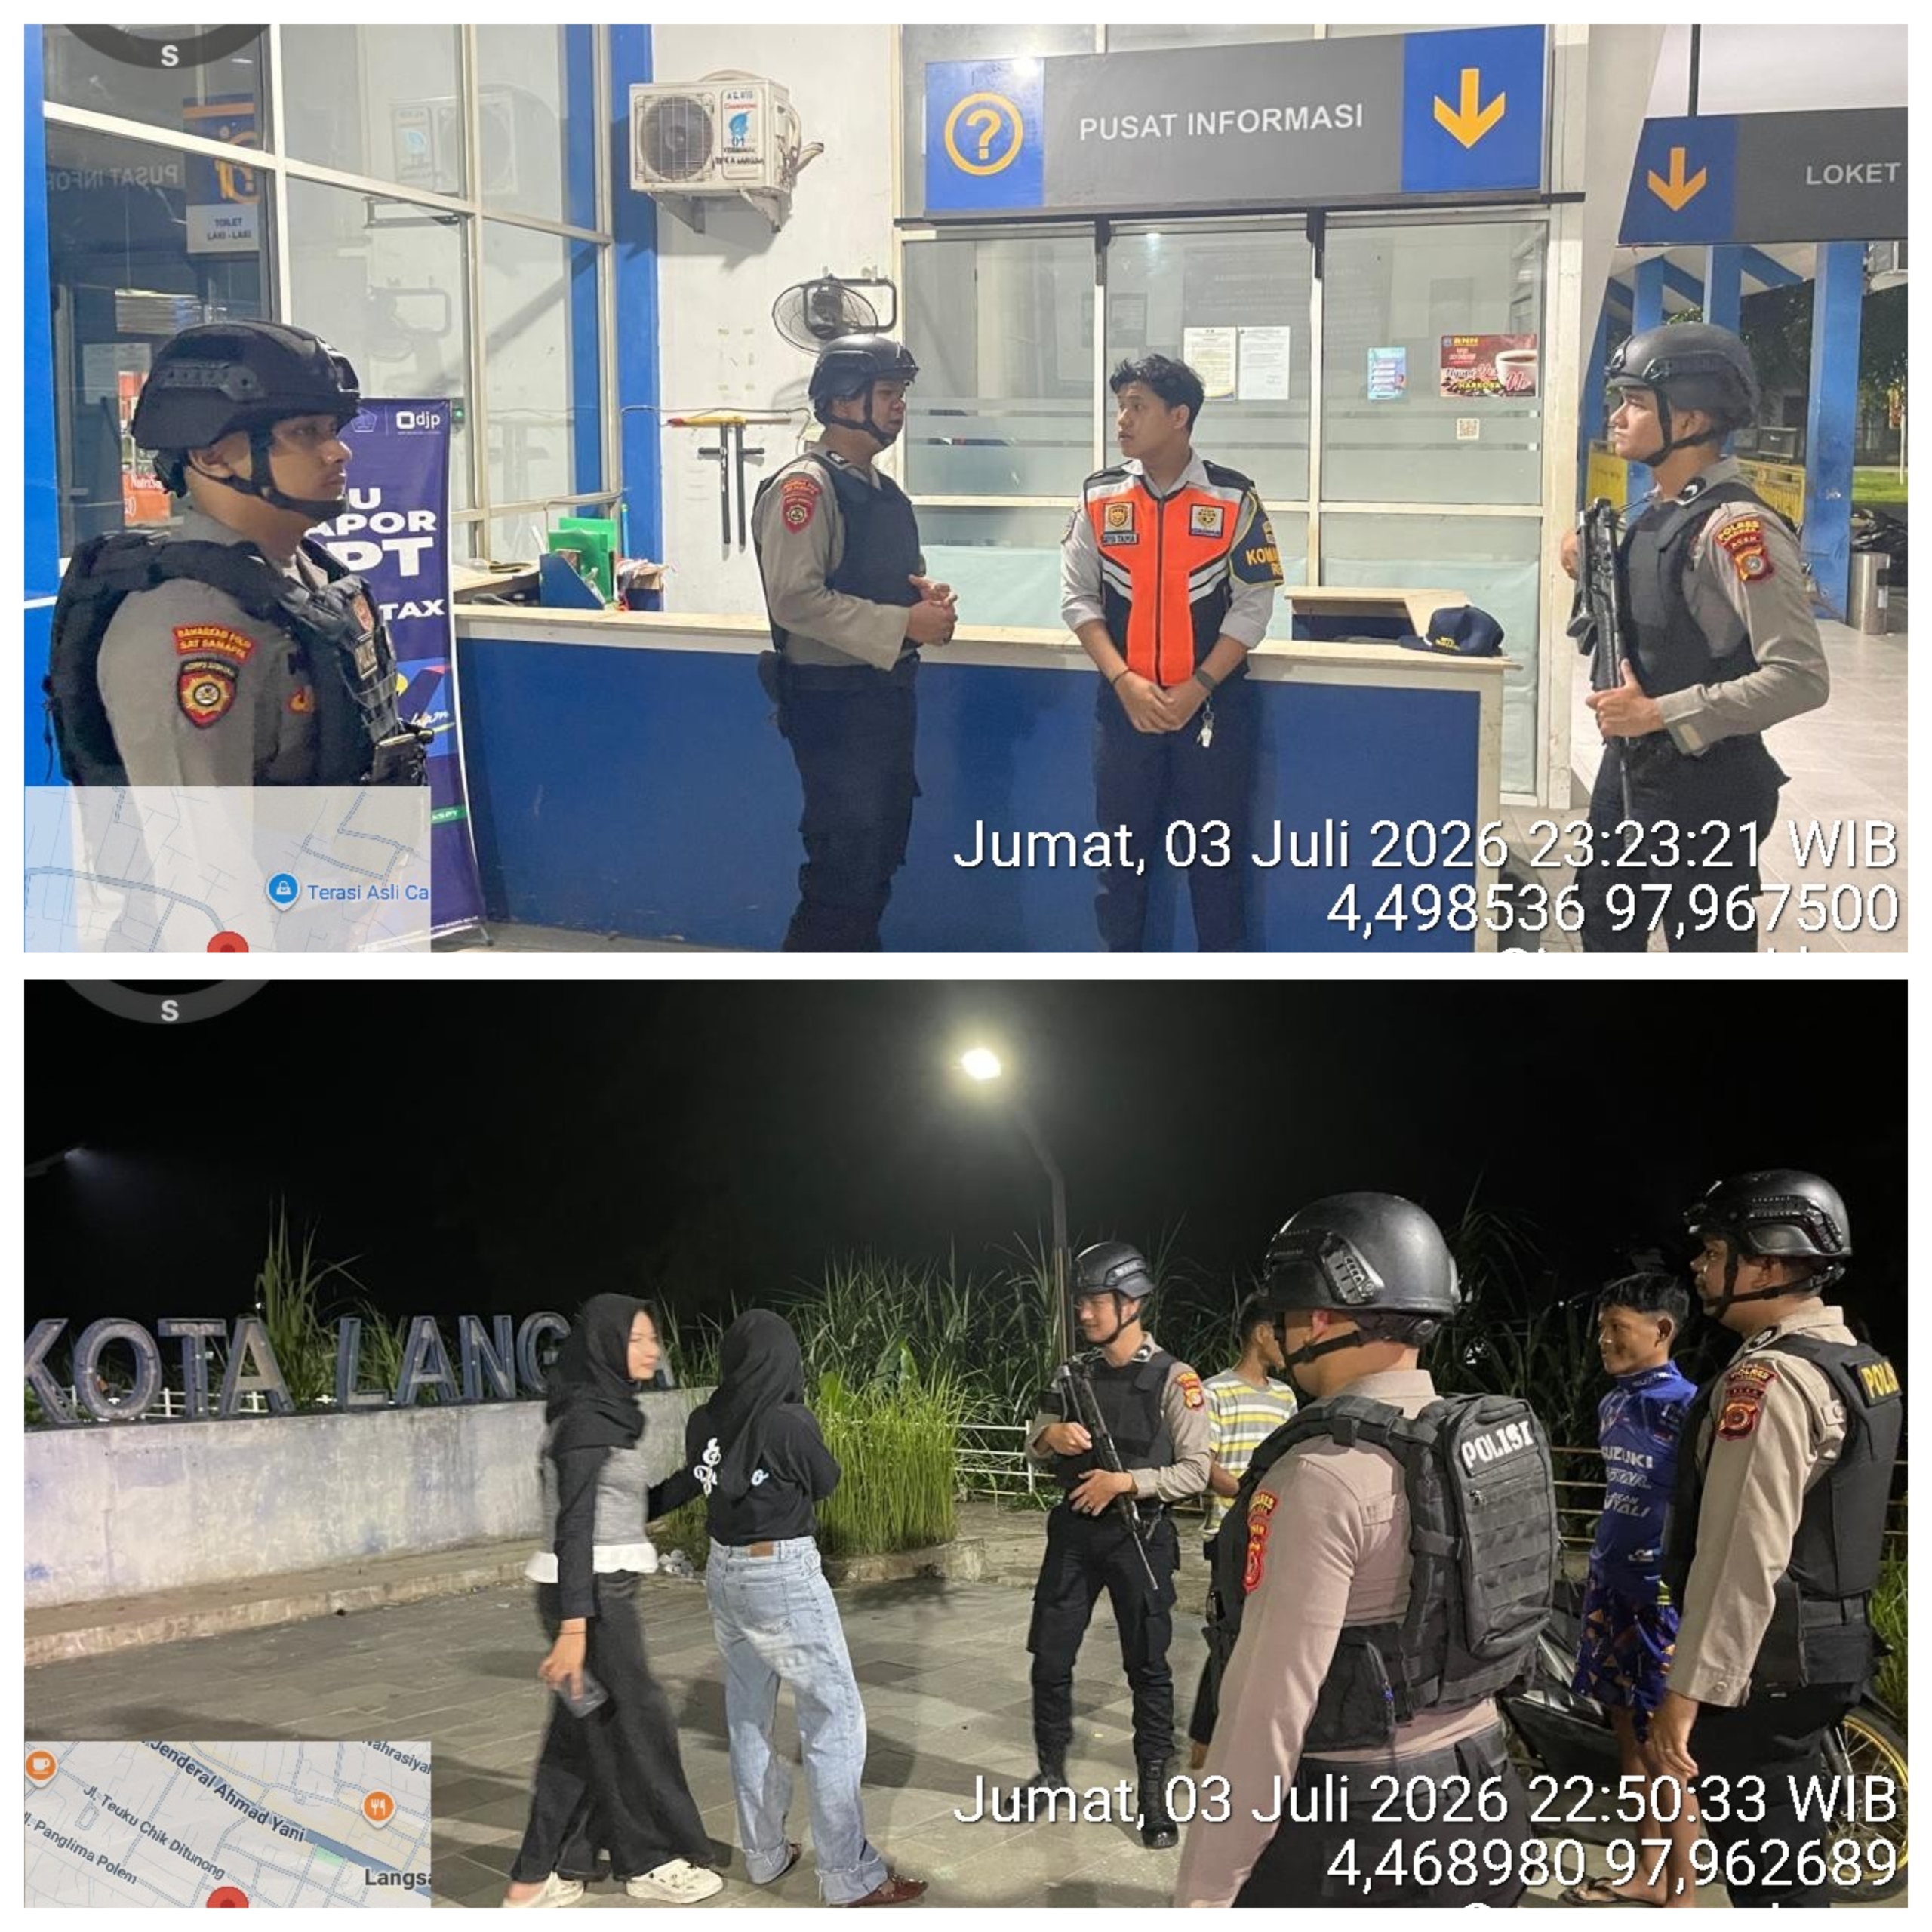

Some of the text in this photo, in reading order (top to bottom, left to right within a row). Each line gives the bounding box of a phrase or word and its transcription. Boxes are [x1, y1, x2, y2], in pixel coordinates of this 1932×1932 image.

[1079, 103, 1363, 140] PUSAT INFORMASI
[1807, 162, 1902, 185] LOKET
[214, 217, 243, 227] TOILET
[349, 488, 381, 509] U
[303, 510, 437, 537] APOR
[1717, 520, 1760, 541] POLRES
[24, 1318, 295, 1425] KOTA
[1461, 1420, 1534, 1469] POLISI
